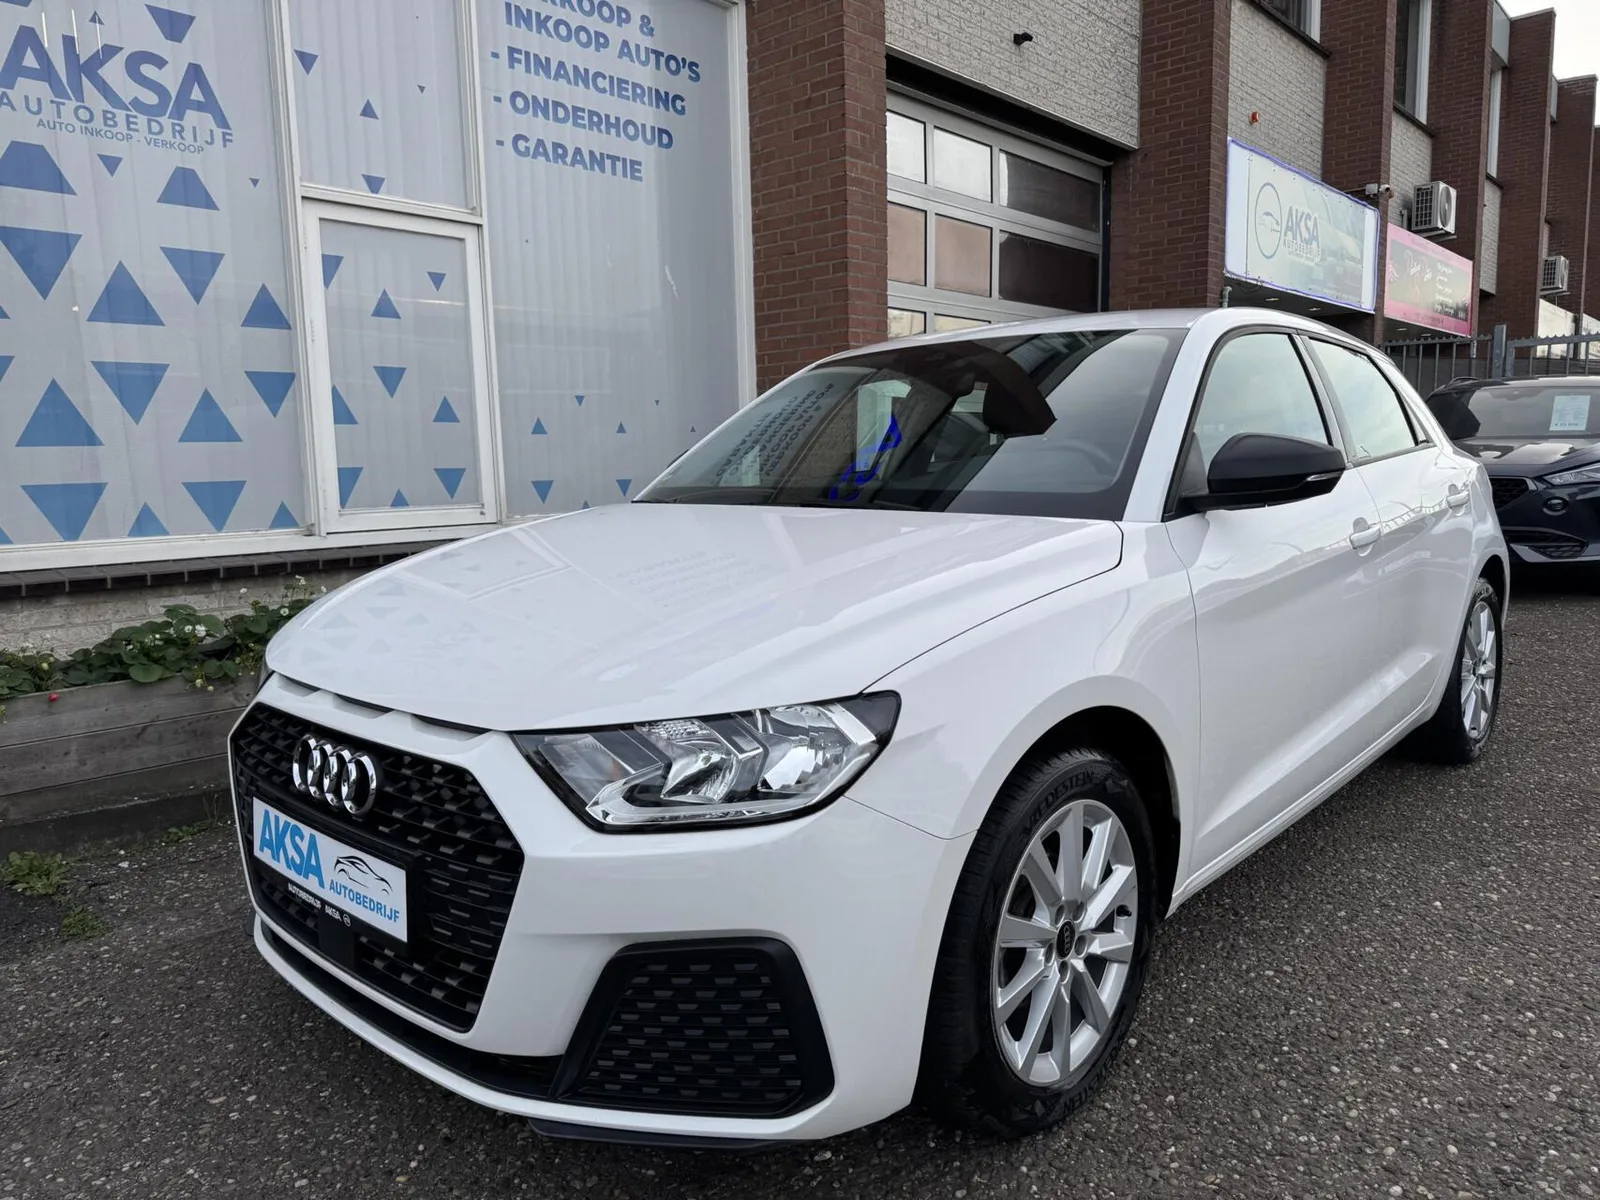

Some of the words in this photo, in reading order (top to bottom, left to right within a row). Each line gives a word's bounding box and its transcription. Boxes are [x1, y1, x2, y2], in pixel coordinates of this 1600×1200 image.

[504, 1, 610, 52] INKOOP
[617, 39, 701, 83] AUTO'S
[639, 14, 655, 37] &
[0, 24, 232, 130] AKSA
[507, 45, 687, 116] FINANCIERING
[0, 91, 234, 148] AUTOBEDRIJF
[37, 118, 76, 134] AUTO
[79, 124, 134, 143] INKOOP
[144, 136, 205, 155] VERKOOP
[509, 90, 674, 150] ONDERHOUD
[511, 133, 644, 182] GARANTIE
[1284, 205, 1320, 250] AKSA
[259, 809, 325, 889] AKSA
[329, 879, 400, 923] AUTOBEDRIJF
